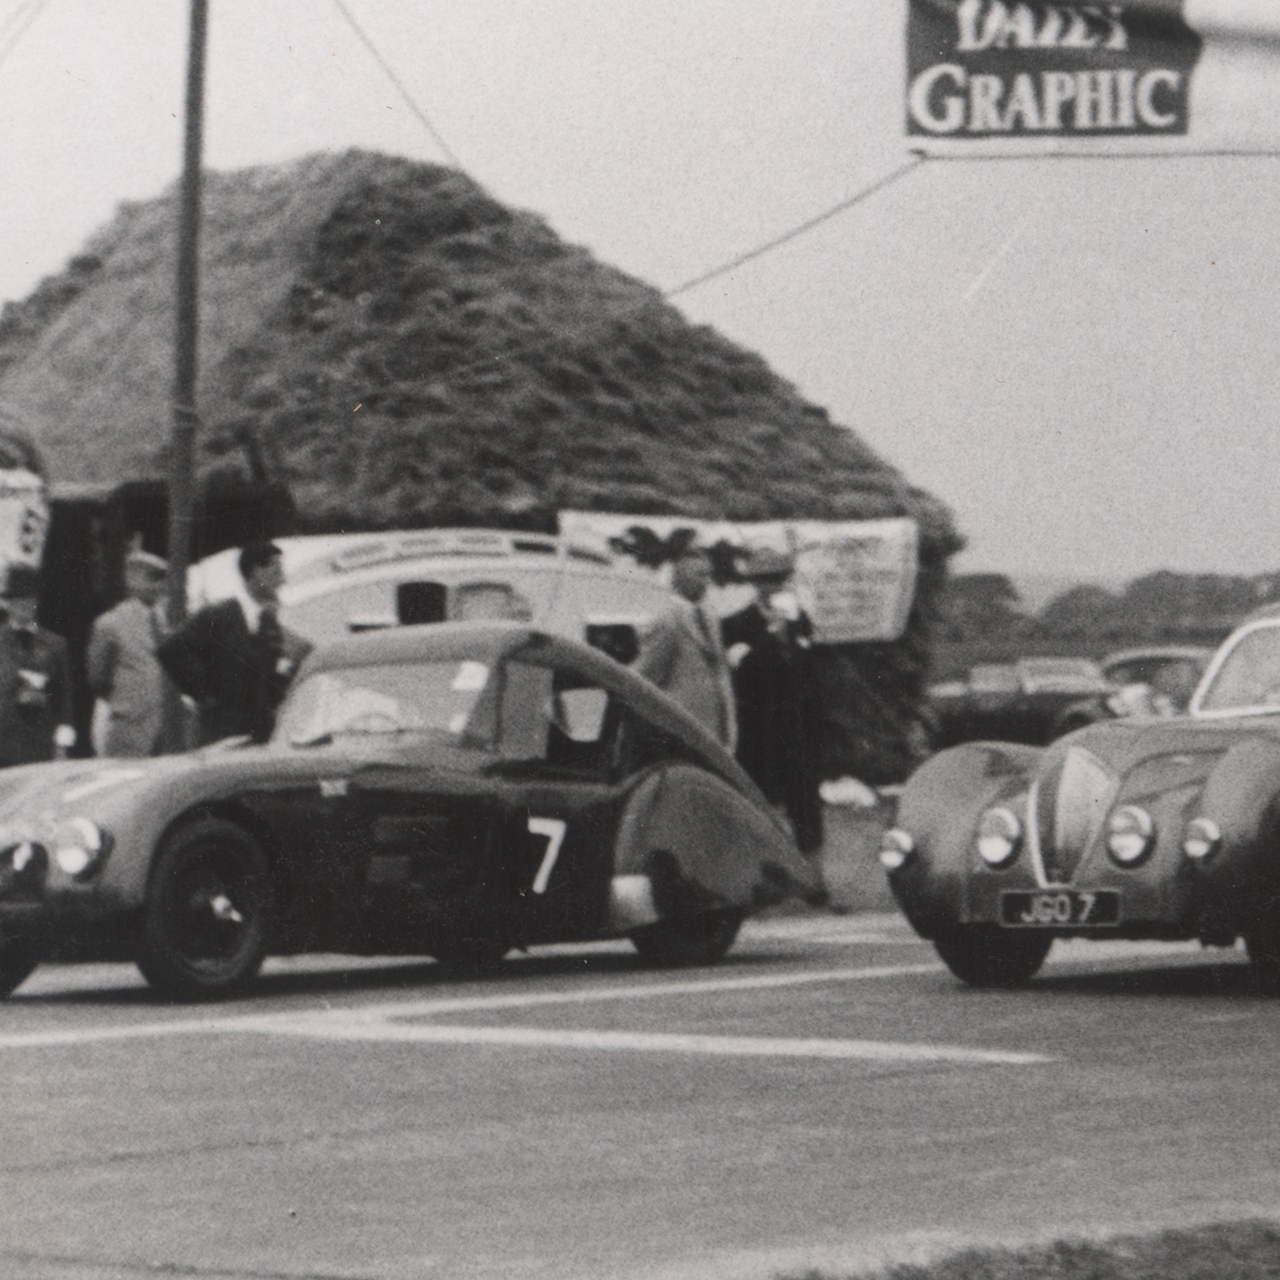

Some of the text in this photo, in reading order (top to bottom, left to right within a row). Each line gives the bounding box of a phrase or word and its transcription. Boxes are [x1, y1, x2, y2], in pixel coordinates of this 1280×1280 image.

[909, 63, 1181, 132] GRAPHIC
[527, 816, 567, 895] 7
[1079, 893, 1096, 924] 7
